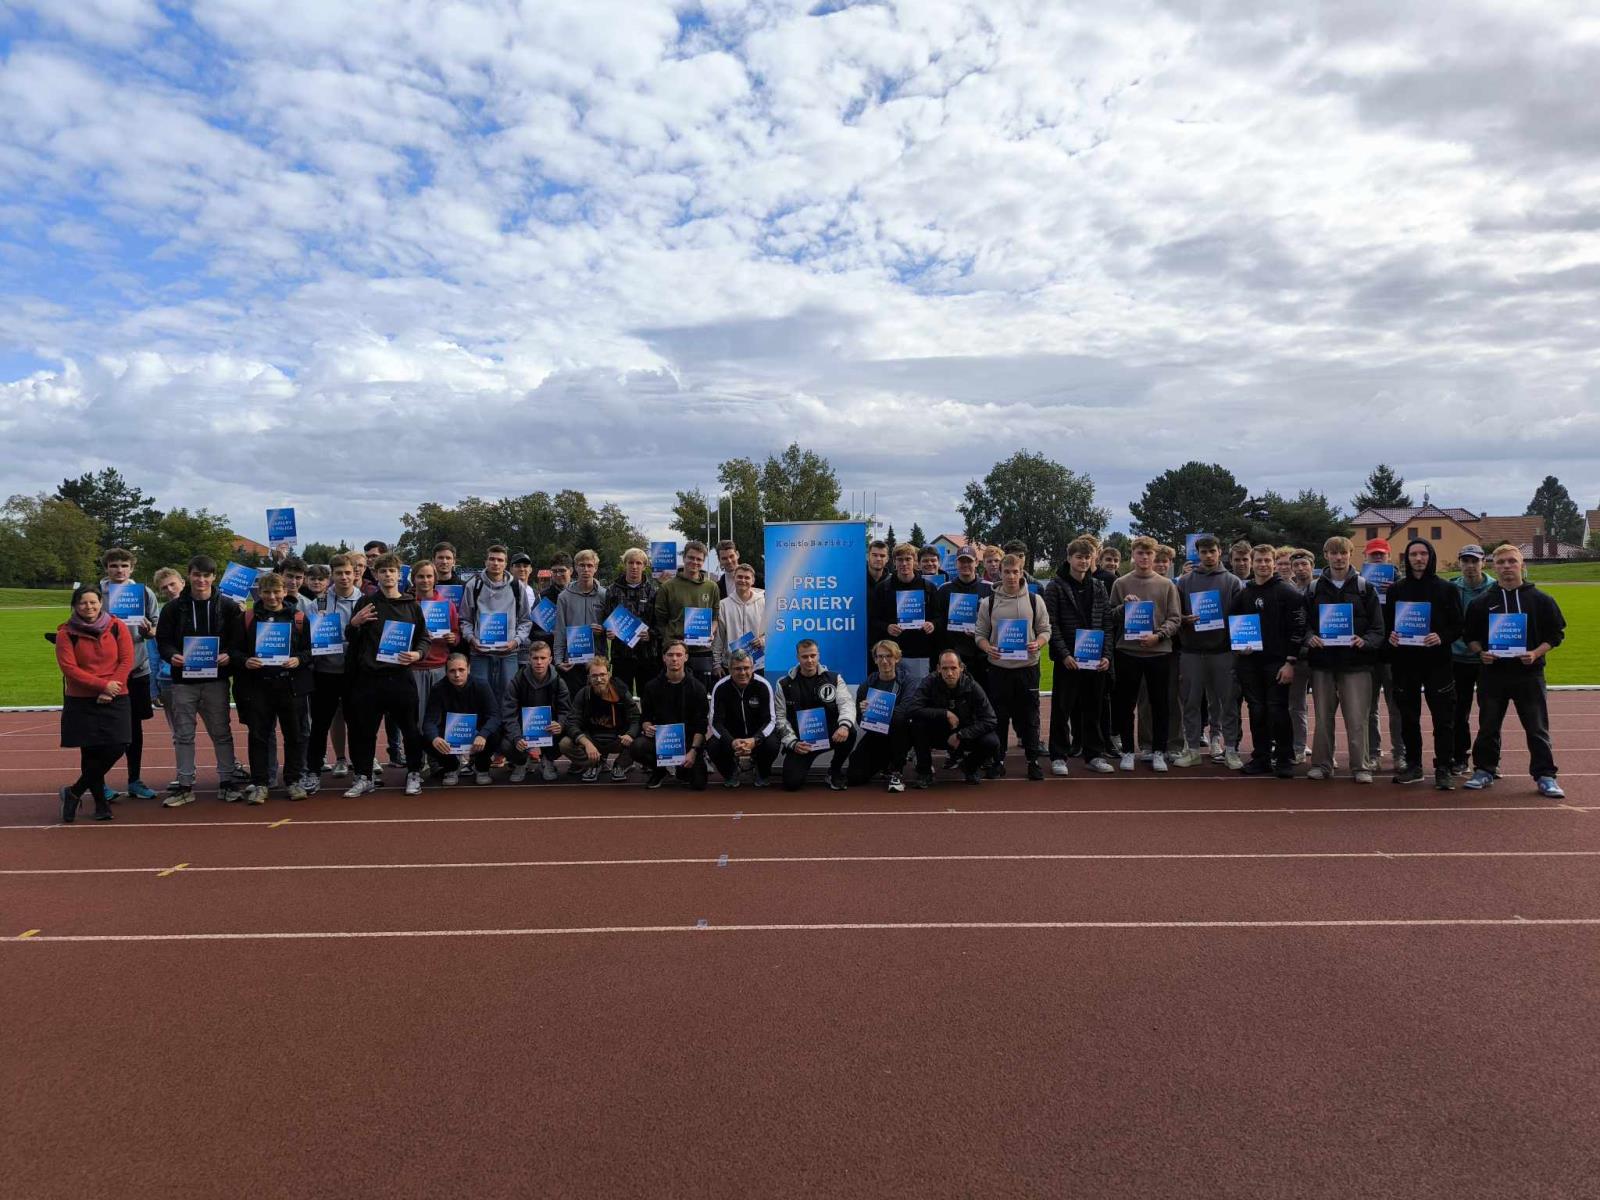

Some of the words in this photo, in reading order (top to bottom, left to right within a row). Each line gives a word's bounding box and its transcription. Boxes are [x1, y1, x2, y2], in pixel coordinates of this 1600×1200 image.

[793, 573, 838, 590] PŘES
[776, 593, 854, 611] BARIÉRY
[775, 618, 786, 632] S
[792, 614, 856, 632] POLICIÍ
